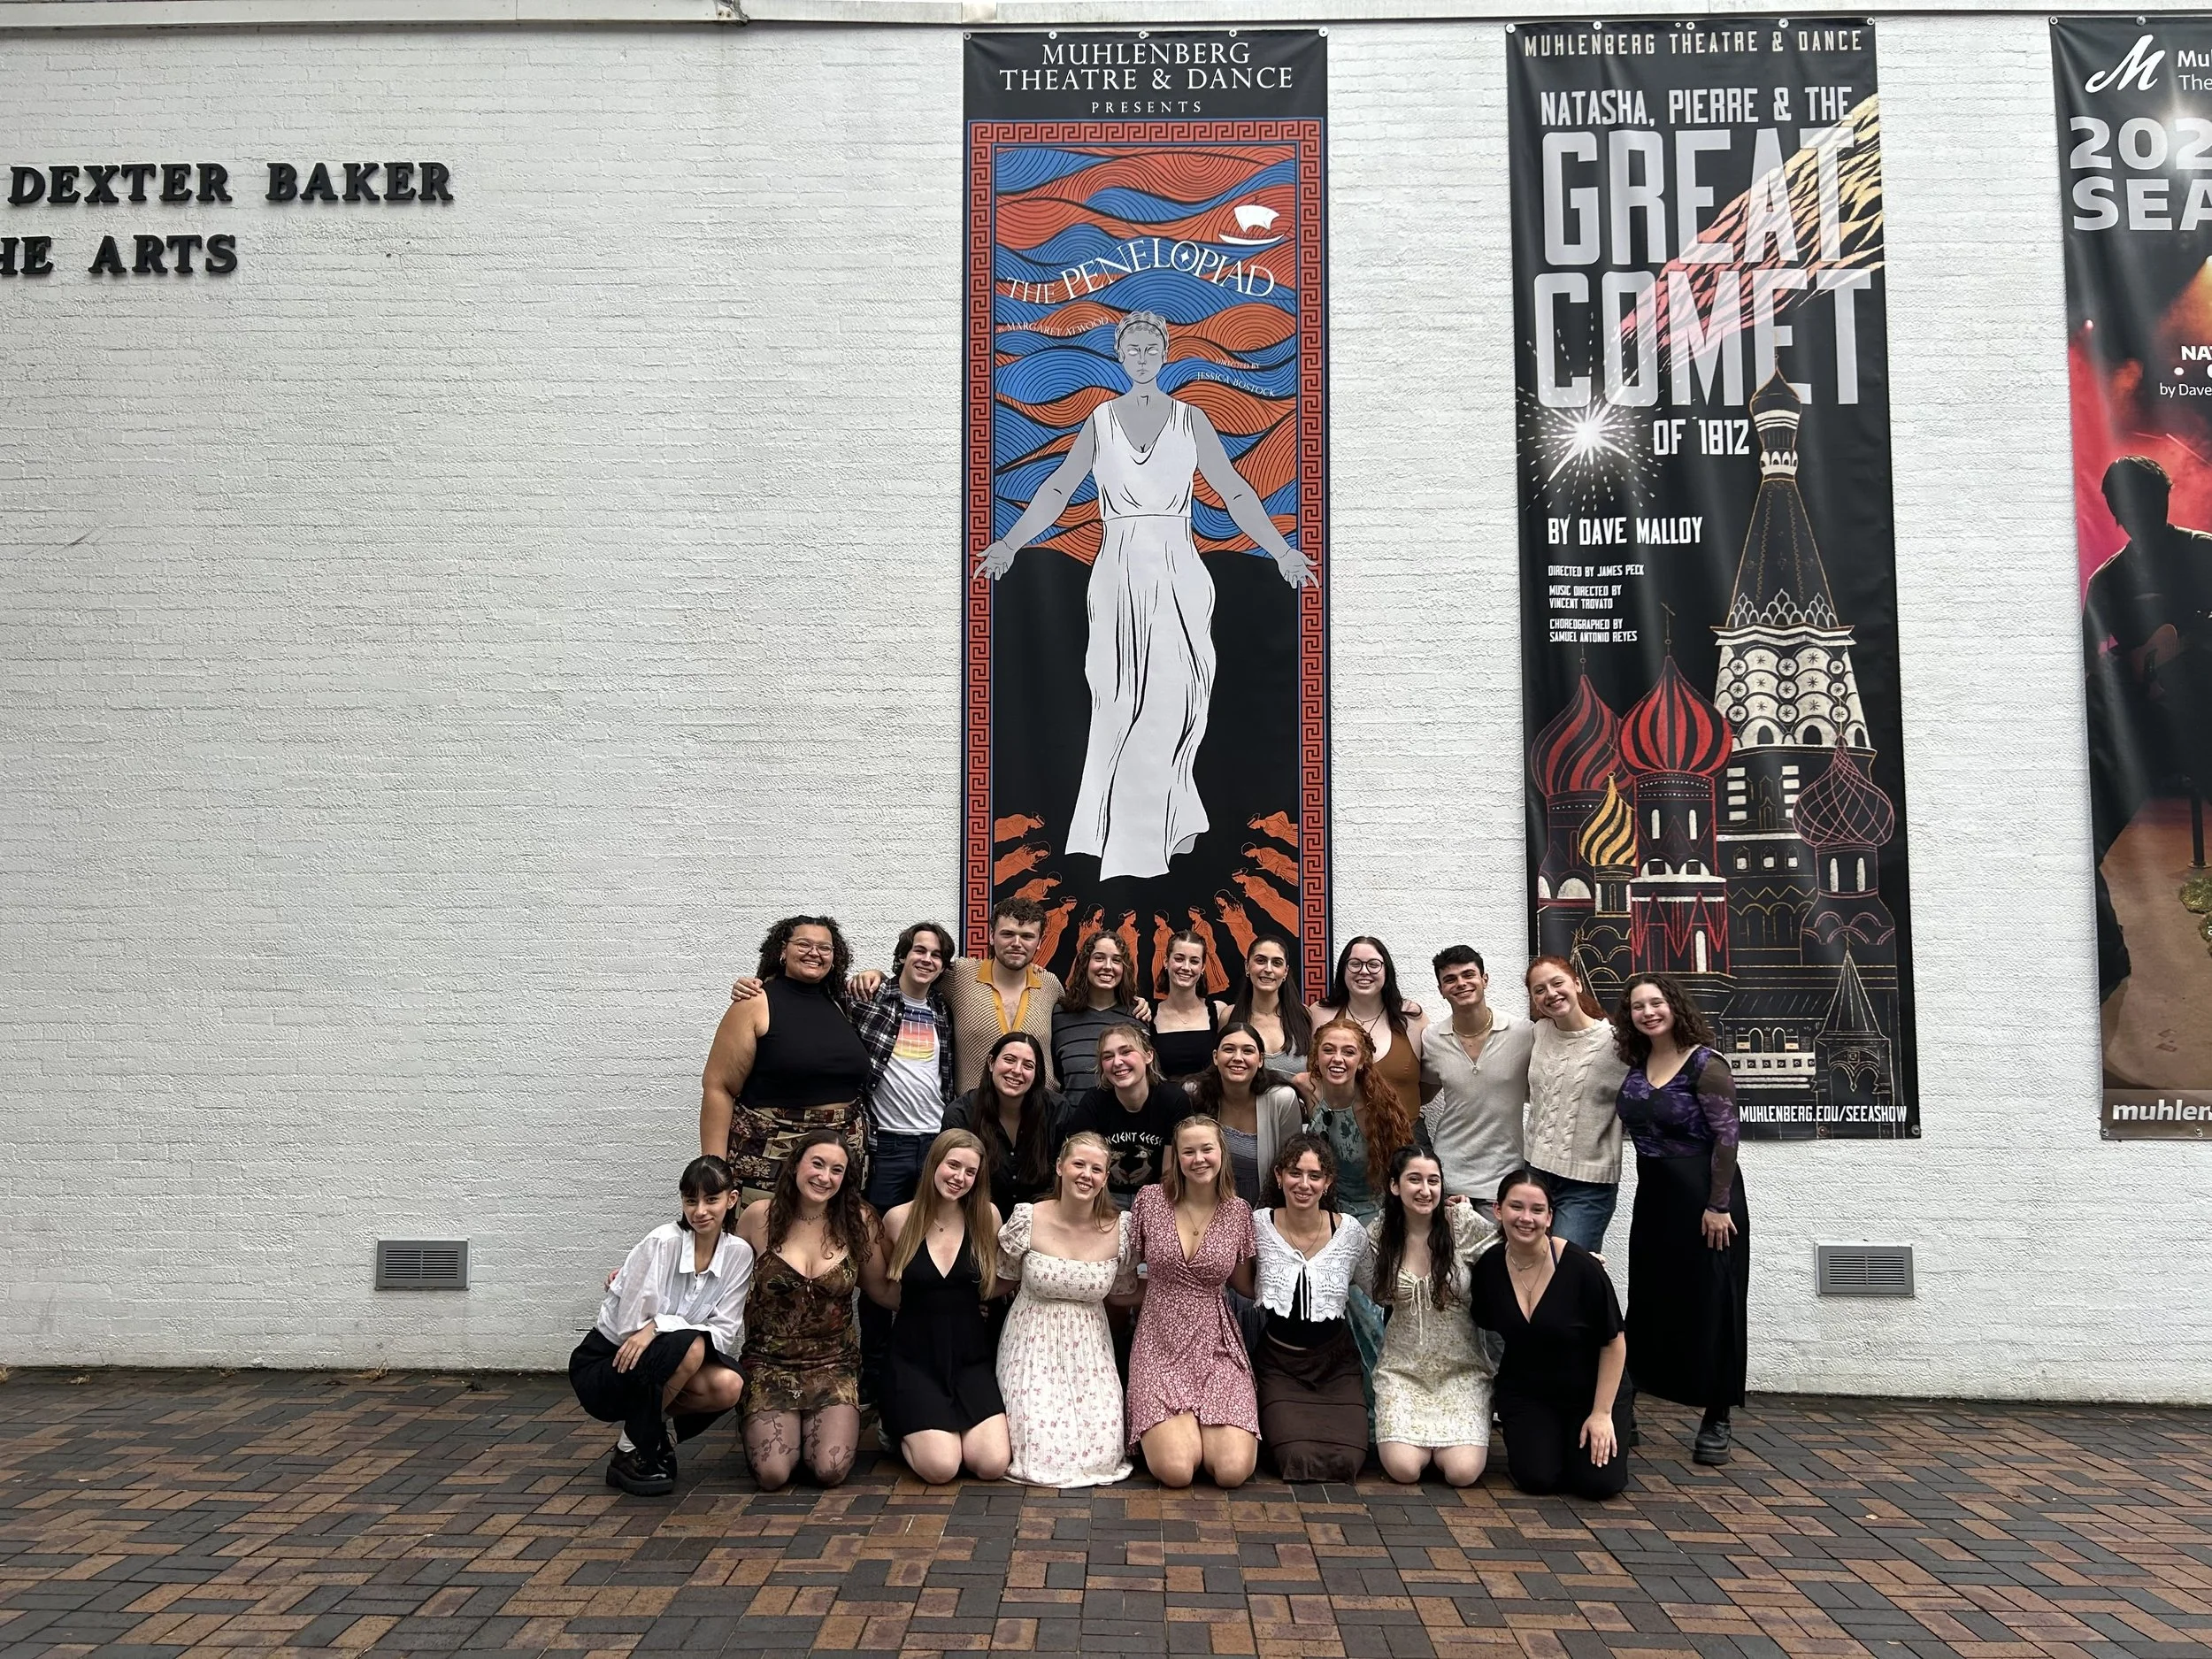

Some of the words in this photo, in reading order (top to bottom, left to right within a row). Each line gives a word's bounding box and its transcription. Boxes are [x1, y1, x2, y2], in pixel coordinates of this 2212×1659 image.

[1041, 42, 1251, 65] MUHLENBERG
[1525, 34, 1655, 57] MUHLENBERG
[1669, 31, 1758, 53] THEATRE
[1772, 31, 1784, 52] &
[1799, 30, 1862, 51] DANCE
[2085, 35, 2166, 93] M
[2177, 49, 2212, 67] Mu
[999, 68, 1138, 90] THEATRE
[1151, 68, 1171, 90] &
[1187, 66, 1294, 89] DANCE
[2177, 73, 2212, 91] The
[1091, 100, 1202, 114] PRESENTS
[1540, 89, 1655, 127] NATASHA,
[1669, 87, 1759, 125] PIERRE
[1773, 87, 1792, 121] &
[1804, 86, 1853, 121] THE
[2070, 116, 2212, 171] 202
[7, 163, 233, 205] DEXTER
[265, 162, 455, 202] BAKER
[1542, 127, 1855, 265] GREAT
[2072, 176, 2212, 231] SEA
[88, 234, 238, 275] ARTS
[1006, 276, 1057, 305] THE
[1060, 237, 1274, 301] PENELOPIAD
[1007, 321, 1062, 337] MARGARET
[1064, 317, 1109, 336] ATWOOD
[1534, 268, 1871, 409] COMET
[2181, 345, 2212, 361] NA
[1197, 372, 1230, 384] JESSICA
[1233, 378, 1275, 397] BOSTOCK
[2160, 382, 2176, 398] by
[2178, 383, 2212, 396] Dave
[1653, 419, 1686, 456] OF
[1698, 419, 1750, 456] 1812
[1548, 517, 1571, 545] BY
[1578, 517, 1627, 545] DAVE
[1636, 516, 1703, 545] MALLOY
[1548, 565, 1582, 577] DIRECTED
[1585, 566, 1594, 577] BY
[1597, 565, 1623, 577] JAMES
[1625, 565, 1644, 575] PECK
[1549, 585, 1571, 595] MUSIC
[1573, 585, 1609, 596] DIRECTED
[1611, 585, 1622, 595] BY
[1549, 598, 1578, 609] VINCENT
[1580, 598, 1613, 609] TROVATO
[1549, 618, 1609, 629] CHOREOGRAPHED
[1612, 618, 1623, 629] BY
[1549, 631, 1578, 642] SAMUEL
[1579, 632, 1609, 642] ANTONIO
[1612, 631, 1637, 642] REYES
[1739, 1105, 1908, 1123] MUHLENBERG.EDU/SEEASHOW
[1103, 1132, 1138, 1146] NCIENT
[1139, 1132, 1164, 1147] GEESE
